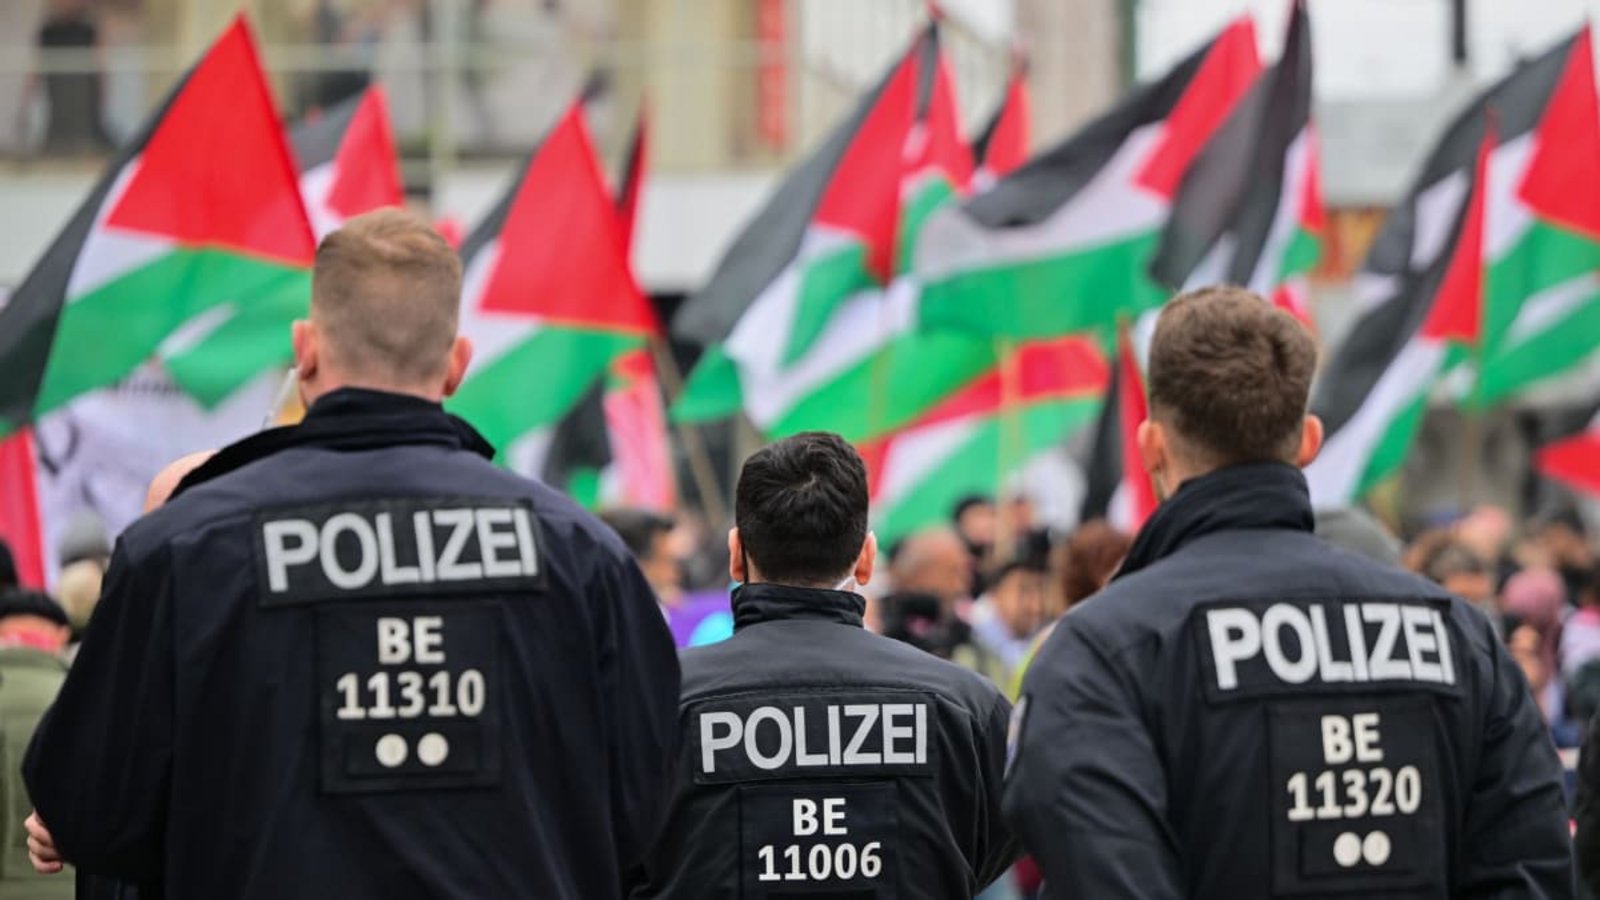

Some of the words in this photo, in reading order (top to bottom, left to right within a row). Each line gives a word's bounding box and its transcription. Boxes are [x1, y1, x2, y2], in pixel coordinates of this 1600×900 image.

[263, 508, 538, 591] POLIZEI
[377, 616, 445, 664] BE
[1206, 603, 1456, 689] POLIZEI
[337, 669, 485, 719] 11310
[700, 703, 928, 773] POLIZEI
[1321, 713, 1384, 764] BE
[792, 797, 848, 836] BE
[1287, 766, 1421, 821] 11320
[758, 841, 882, 881] 11006
